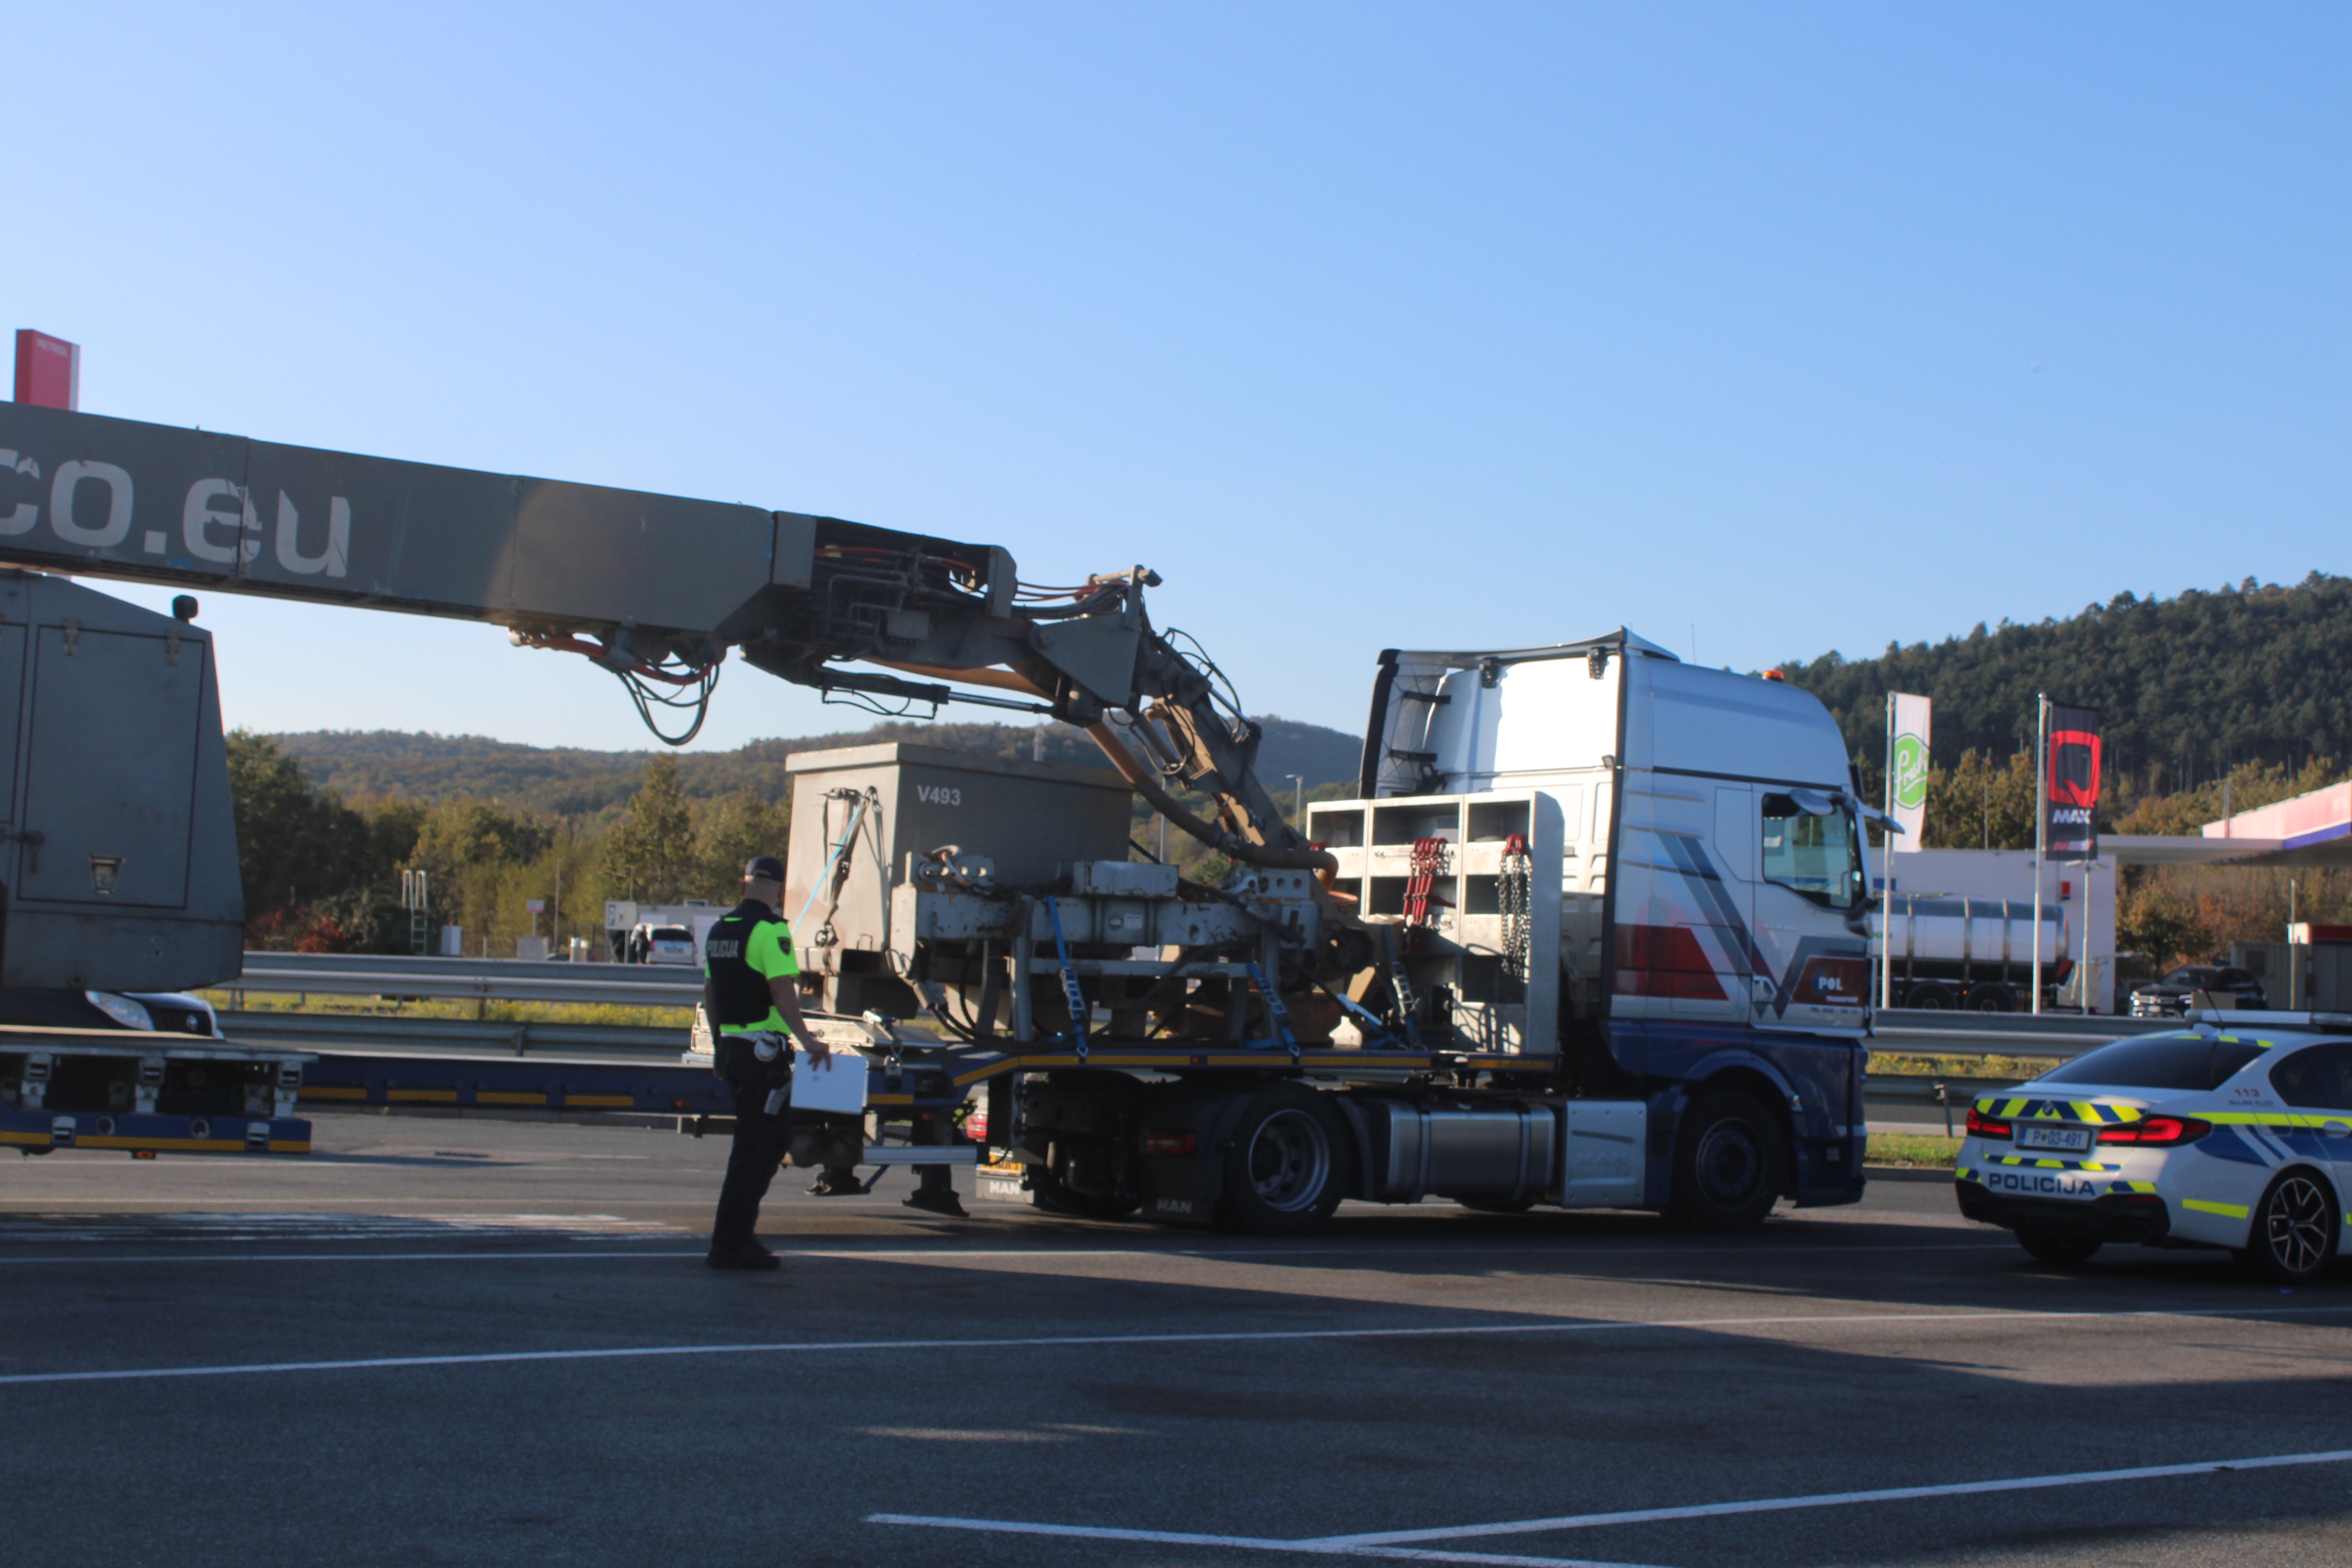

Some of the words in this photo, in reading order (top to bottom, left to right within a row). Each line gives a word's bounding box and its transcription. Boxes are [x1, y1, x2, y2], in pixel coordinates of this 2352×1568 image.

[917, 785, 961, 806] V493
[2052, 809, 2092, 824] MAX
[707, 939, 739, 958] POLICIJA
[1818, 976, 1843, 991] POL
[2234, 1088, 2260, 1097] 113
[2032, 1130, 2041, 1144] P
[989, 1181, 1020, 1195] MAN
[1988, 1172, 2096, 1195] POLICIJA
[1157, 1198, 1192, 1213] MAN
